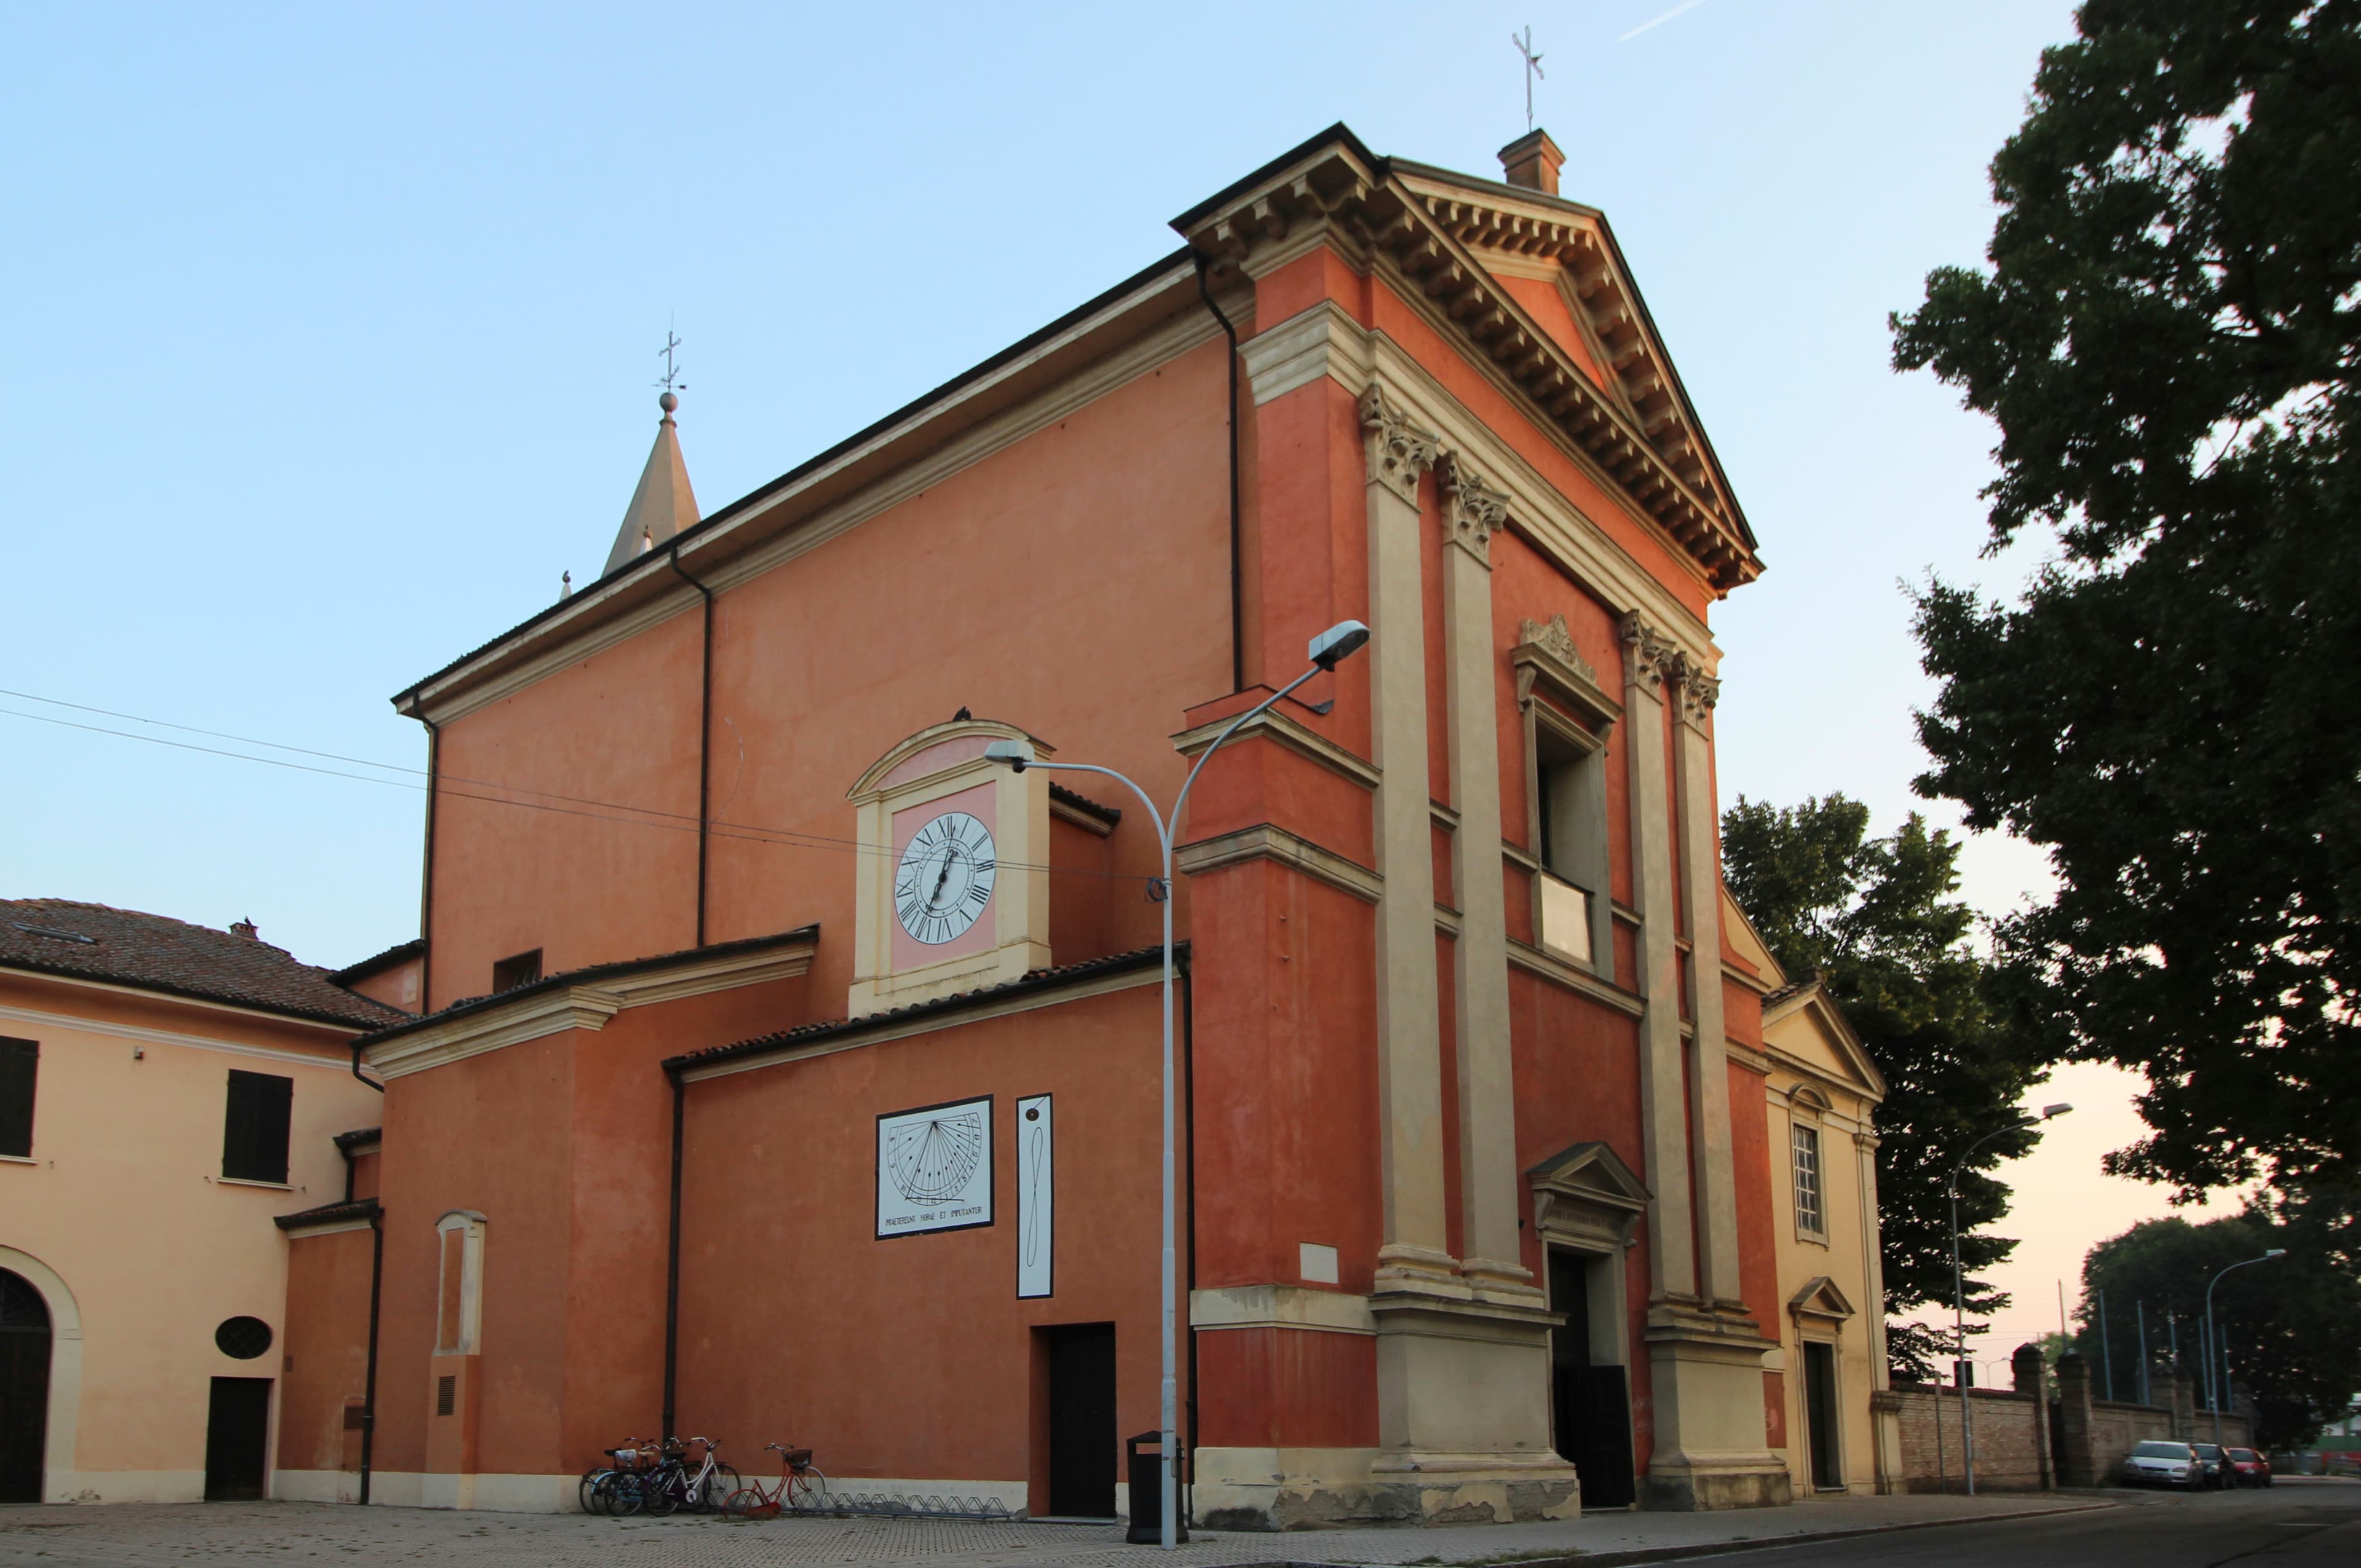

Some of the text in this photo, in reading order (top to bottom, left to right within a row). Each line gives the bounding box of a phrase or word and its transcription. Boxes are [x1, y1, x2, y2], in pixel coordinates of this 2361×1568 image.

[938, 815, 952, 841] XII
[959, 817, 970, 838] I
[971, 833, 989, 852] II
[976, 859, 994, 873] III
[970, 884, 990, 905] IIII
[959, 909, 973, 931] V
[920, 1212, 935, 1222] HORAE
[939, 1211, 946, 1219] ET
[951, 1206, 983, 1218] IMPUTANTUR
